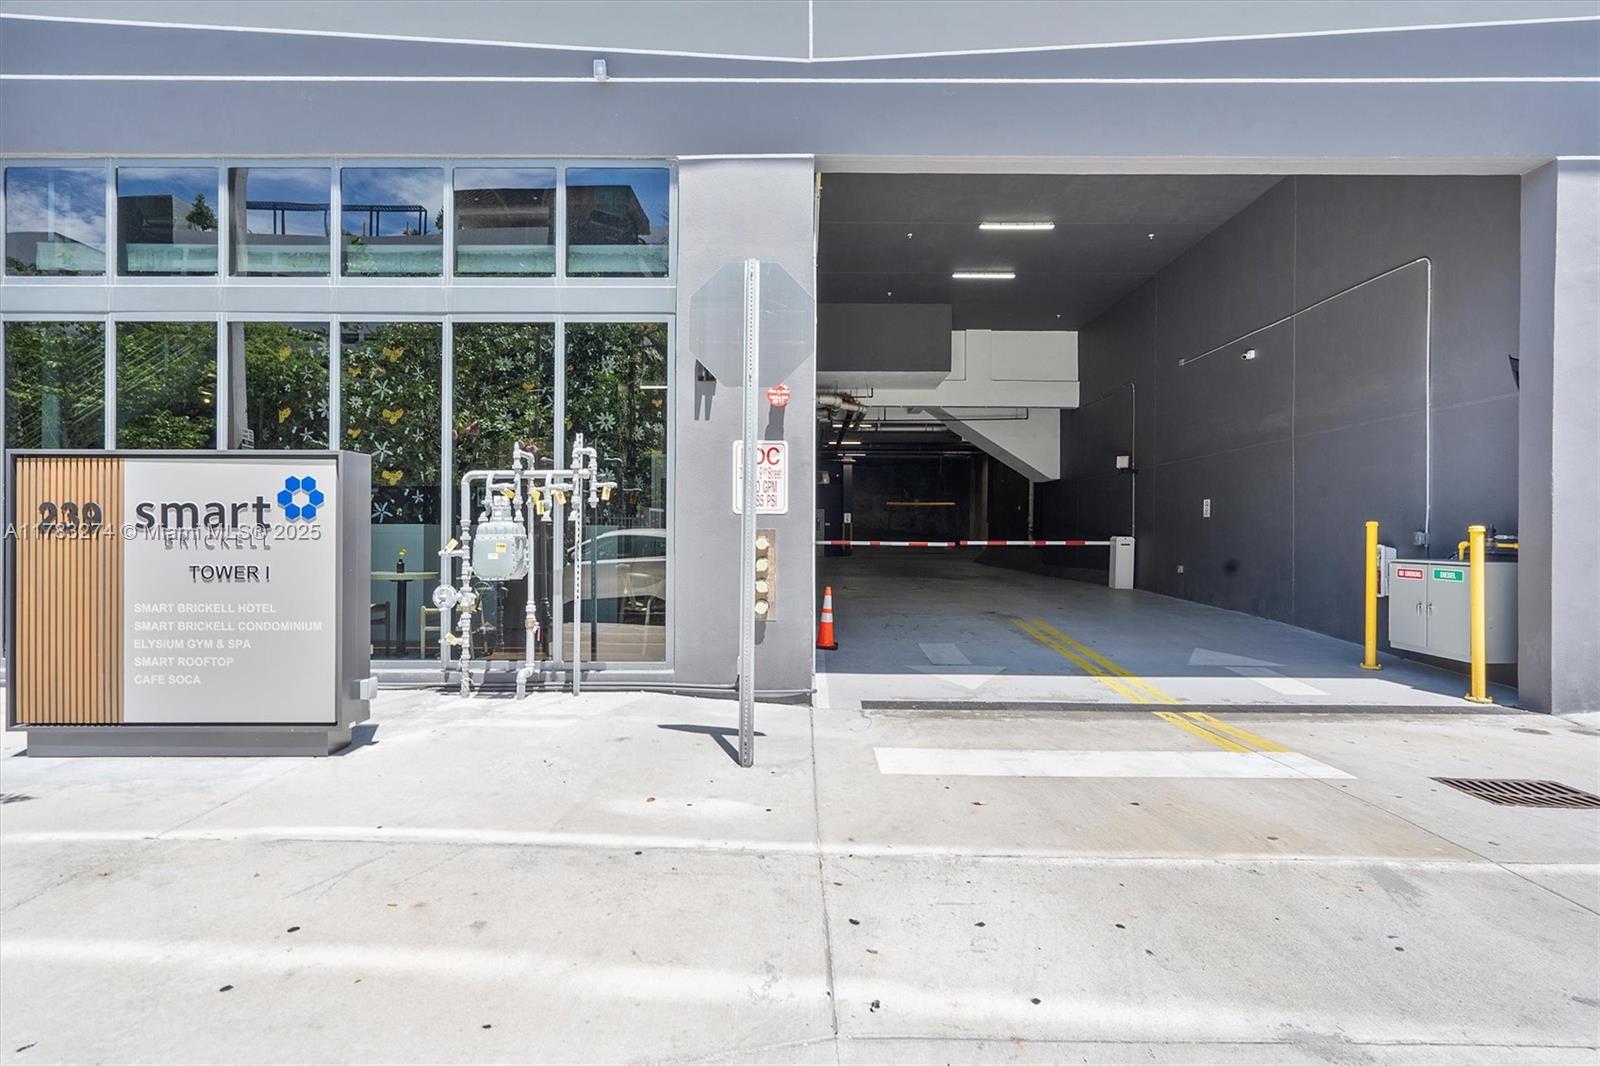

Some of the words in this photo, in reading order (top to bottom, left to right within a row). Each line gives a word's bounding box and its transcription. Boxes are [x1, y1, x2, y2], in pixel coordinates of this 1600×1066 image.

[767, 494, 778, 507] PSI
[135, 496, 271, 530] smart
[164, 534, 271, 550] BRICKELL
[189, 565, 259, 583] TOWER
[265, 565, 271, 583] I
[134, 603, 174, 613] SMART
[178, 603, 234, 613] BRICKELL
[238, 603, 276, 613] HOTEL
[134, 621, 174, 631] SMART
[178, 621, 234, 631] BRICKELL
[238, 621, 322, 631] CONDOMINIUM
[134, 640, 183, 649] ELYSIUM
[188, 639, 213, 649] GYM
[216, 639, 224, 649] &
[228, 639, 251, 649] SPA
[134, 657, 174, 667] SMART
[178, 657, 233, 667] ROOFTOP
[134, 675, 165, 685] CAFE
[169, 675, 201, 685] SOCA
